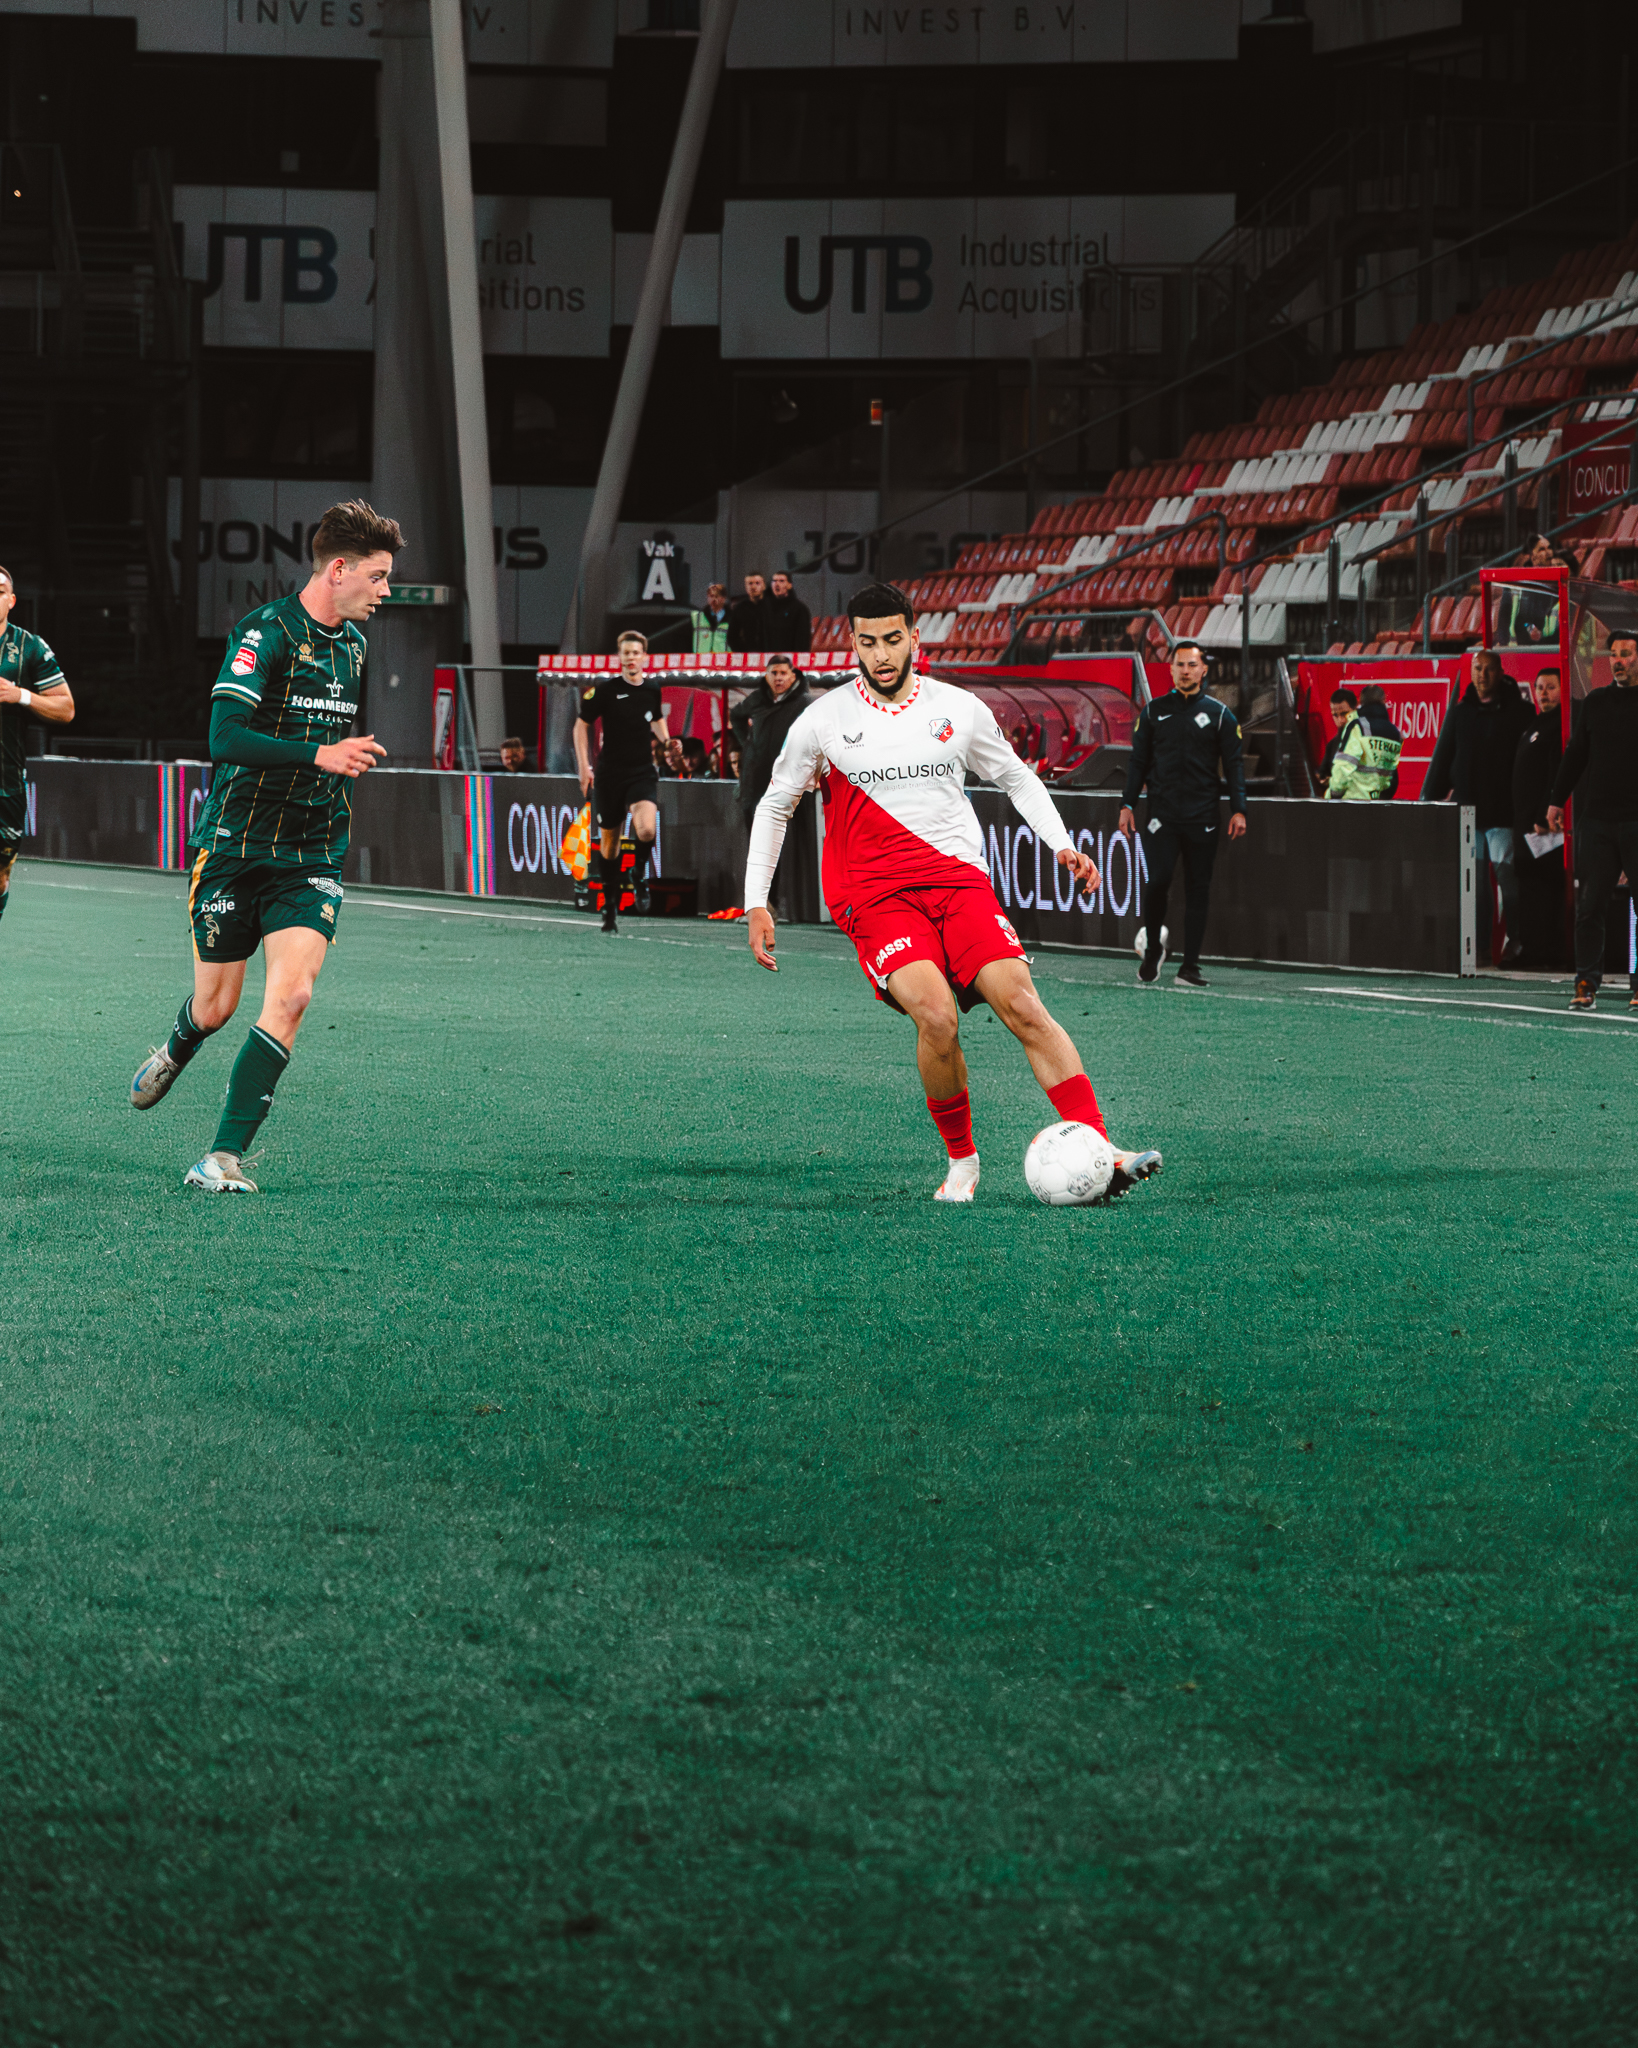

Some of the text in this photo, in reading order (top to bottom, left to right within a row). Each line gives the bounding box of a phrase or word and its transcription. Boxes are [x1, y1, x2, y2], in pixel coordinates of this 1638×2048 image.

[236, 1, 368, 27] INVES
[846, 7, 985, 36] INVEST
[960, 232, 1113, 268] Industrial
[785, 235, 933, 315] UTB
[1574, 464, 1631, 498] CONCLU
[642, 539, 676, 558] Vak
[641, 558, 676, 601] A
[307, 711, 343, 724] CASIN
[1391, 701, 1441, 739] USION
[847, 762, 955, 785] CONCLUSION
[875, 936, 913, 970] DASSY
